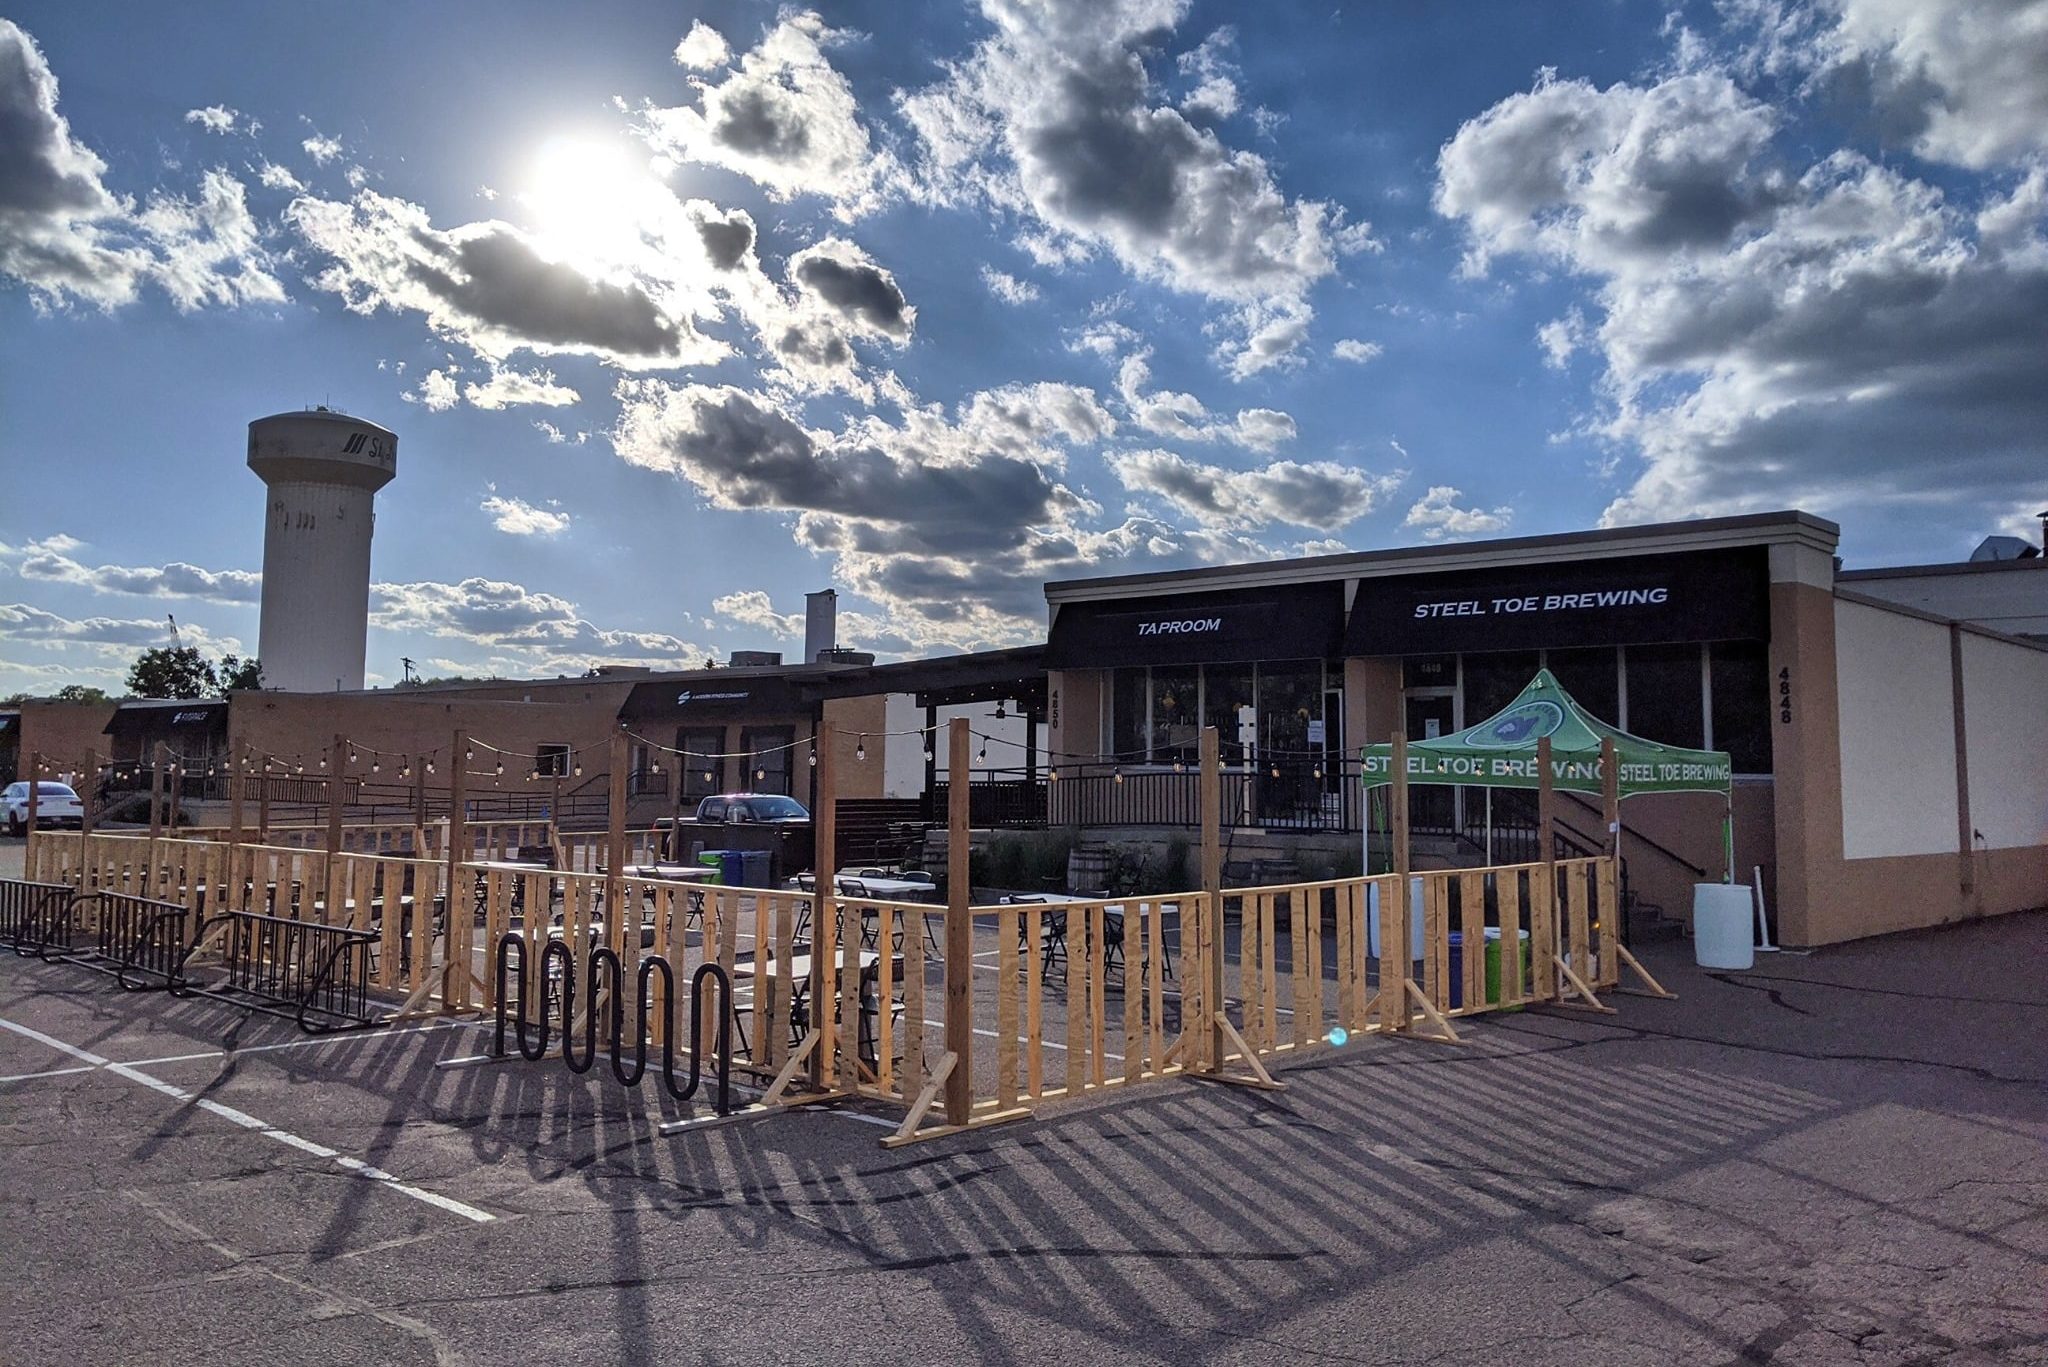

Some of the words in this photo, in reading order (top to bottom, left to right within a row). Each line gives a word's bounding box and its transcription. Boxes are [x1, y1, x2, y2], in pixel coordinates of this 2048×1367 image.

[1414, 601, 1486, 618] STEEL
[1492, 596, 1539, 614] TOE
[1543, 588, 1668, 610] BREWING
[1138, 618, 1221, 635] TAPROOM
[1779, 666, 1791, 723] 4848
[1366, 756, 1434, 773] STEL
[1439, 757, 1485, 775] TOE
[1620, 763, 1657, 781] STEEL
[1659, 763, 1681, 781] TOE
[1682, 763, 1730, 780] BREWING
